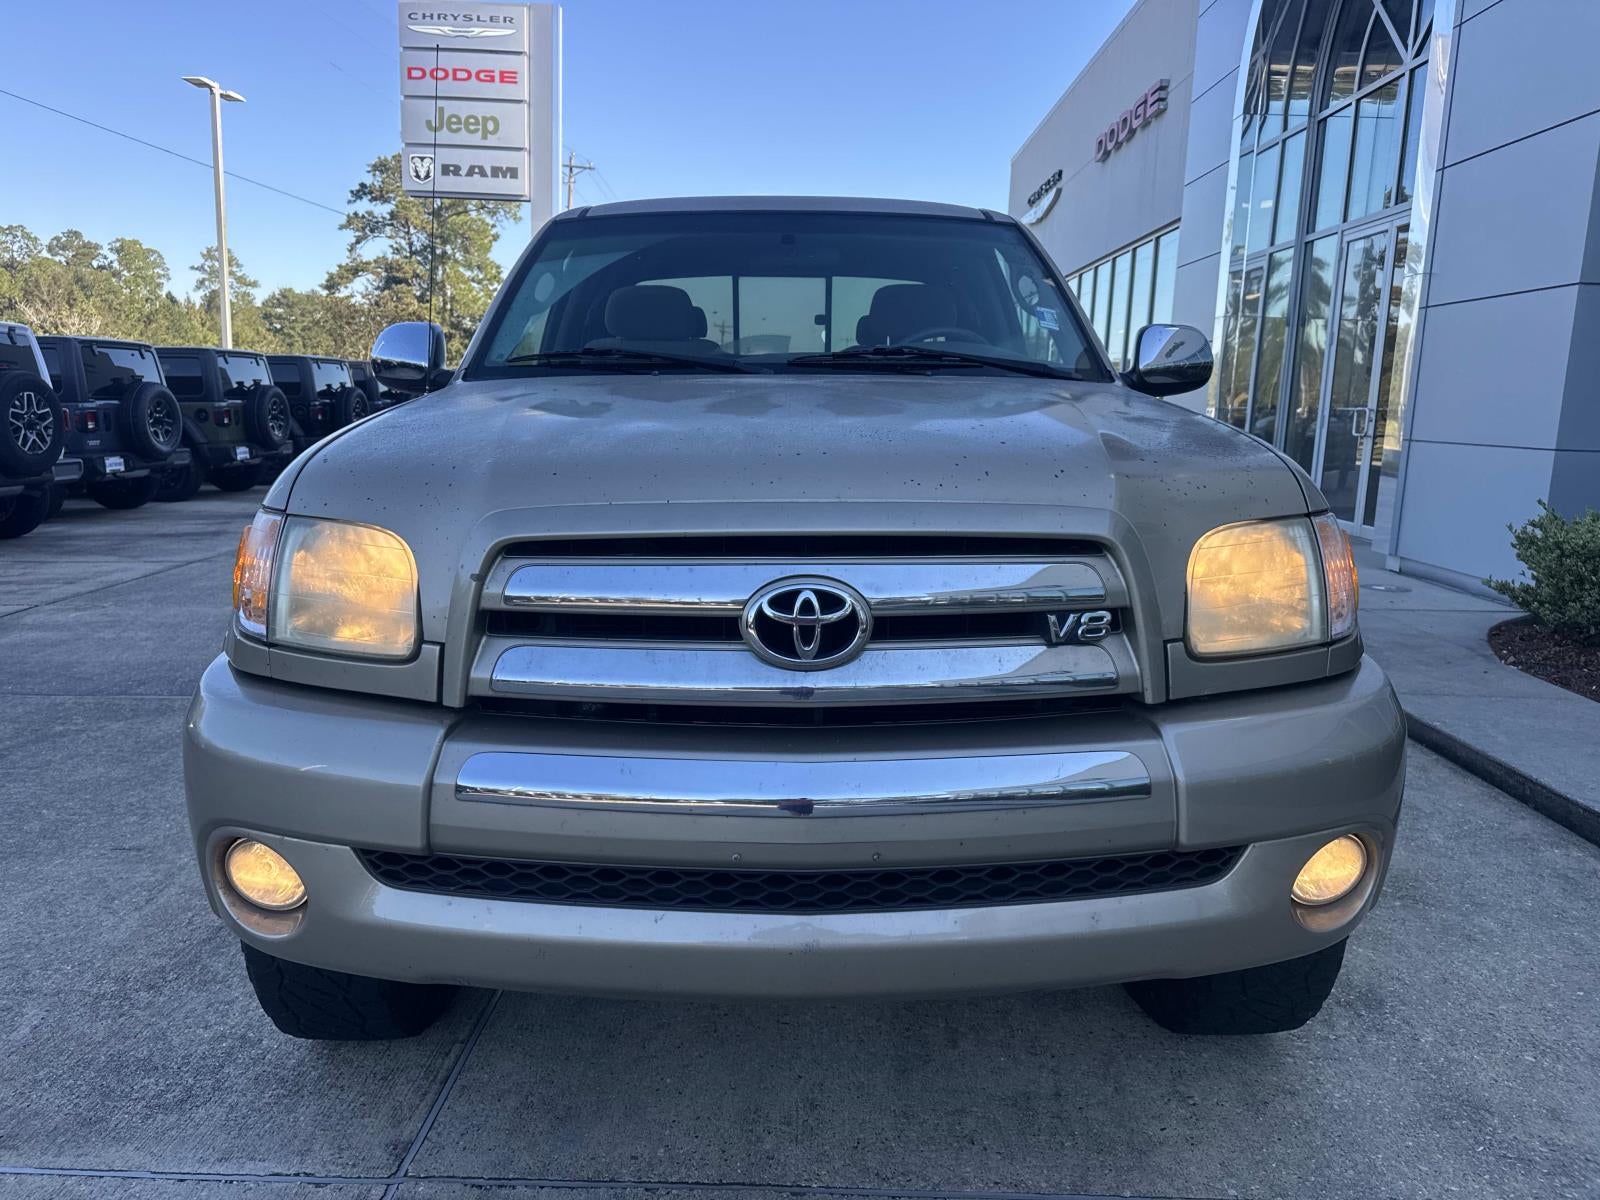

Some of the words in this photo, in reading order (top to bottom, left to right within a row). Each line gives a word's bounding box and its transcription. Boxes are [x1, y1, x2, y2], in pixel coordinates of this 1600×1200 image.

[407, 12, 515, 24] CHRYSLER
[406, 66, 518, 84] DODGE
[425, 106, 500, 140] Jeep
[1095, 79, 1170, 162] DODGE
[440, 163, 519, 179] RAM
[1047, 610, 1112, 643] V8
